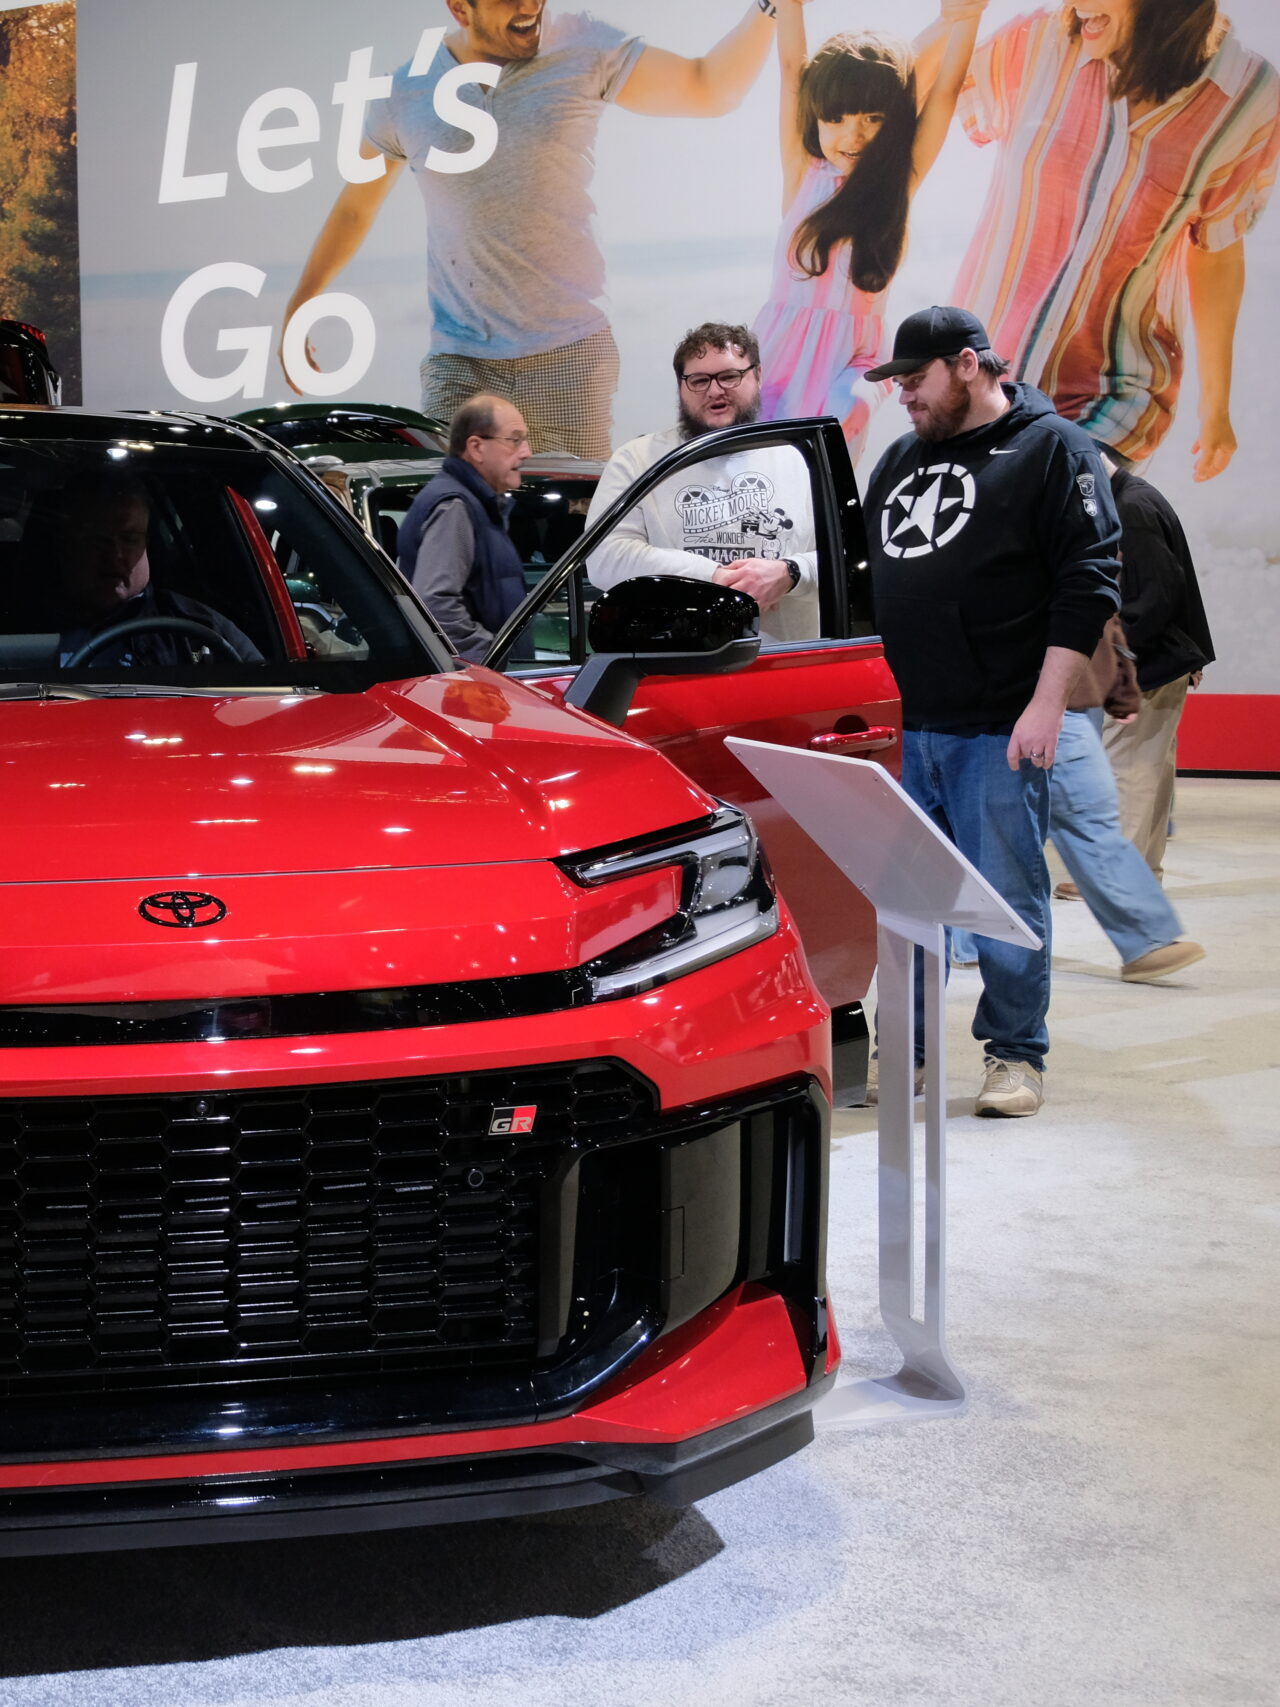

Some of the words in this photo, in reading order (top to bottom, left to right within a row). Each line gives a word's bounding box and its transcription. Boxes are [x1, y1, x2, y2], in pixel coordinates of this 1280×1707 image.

[158, 26, 503, 204] Let's
[160, 261, 376, 402] Go
[684, 502, 724, 527] MICKEY
[728, 493, 766, 518] MOUSE
[683, 533, 716, 544] The
[716, 531, 745, 545] WONDER
[708, 548, 755, 563] MAGIC
[491, 1116, 532, 1133] GR
